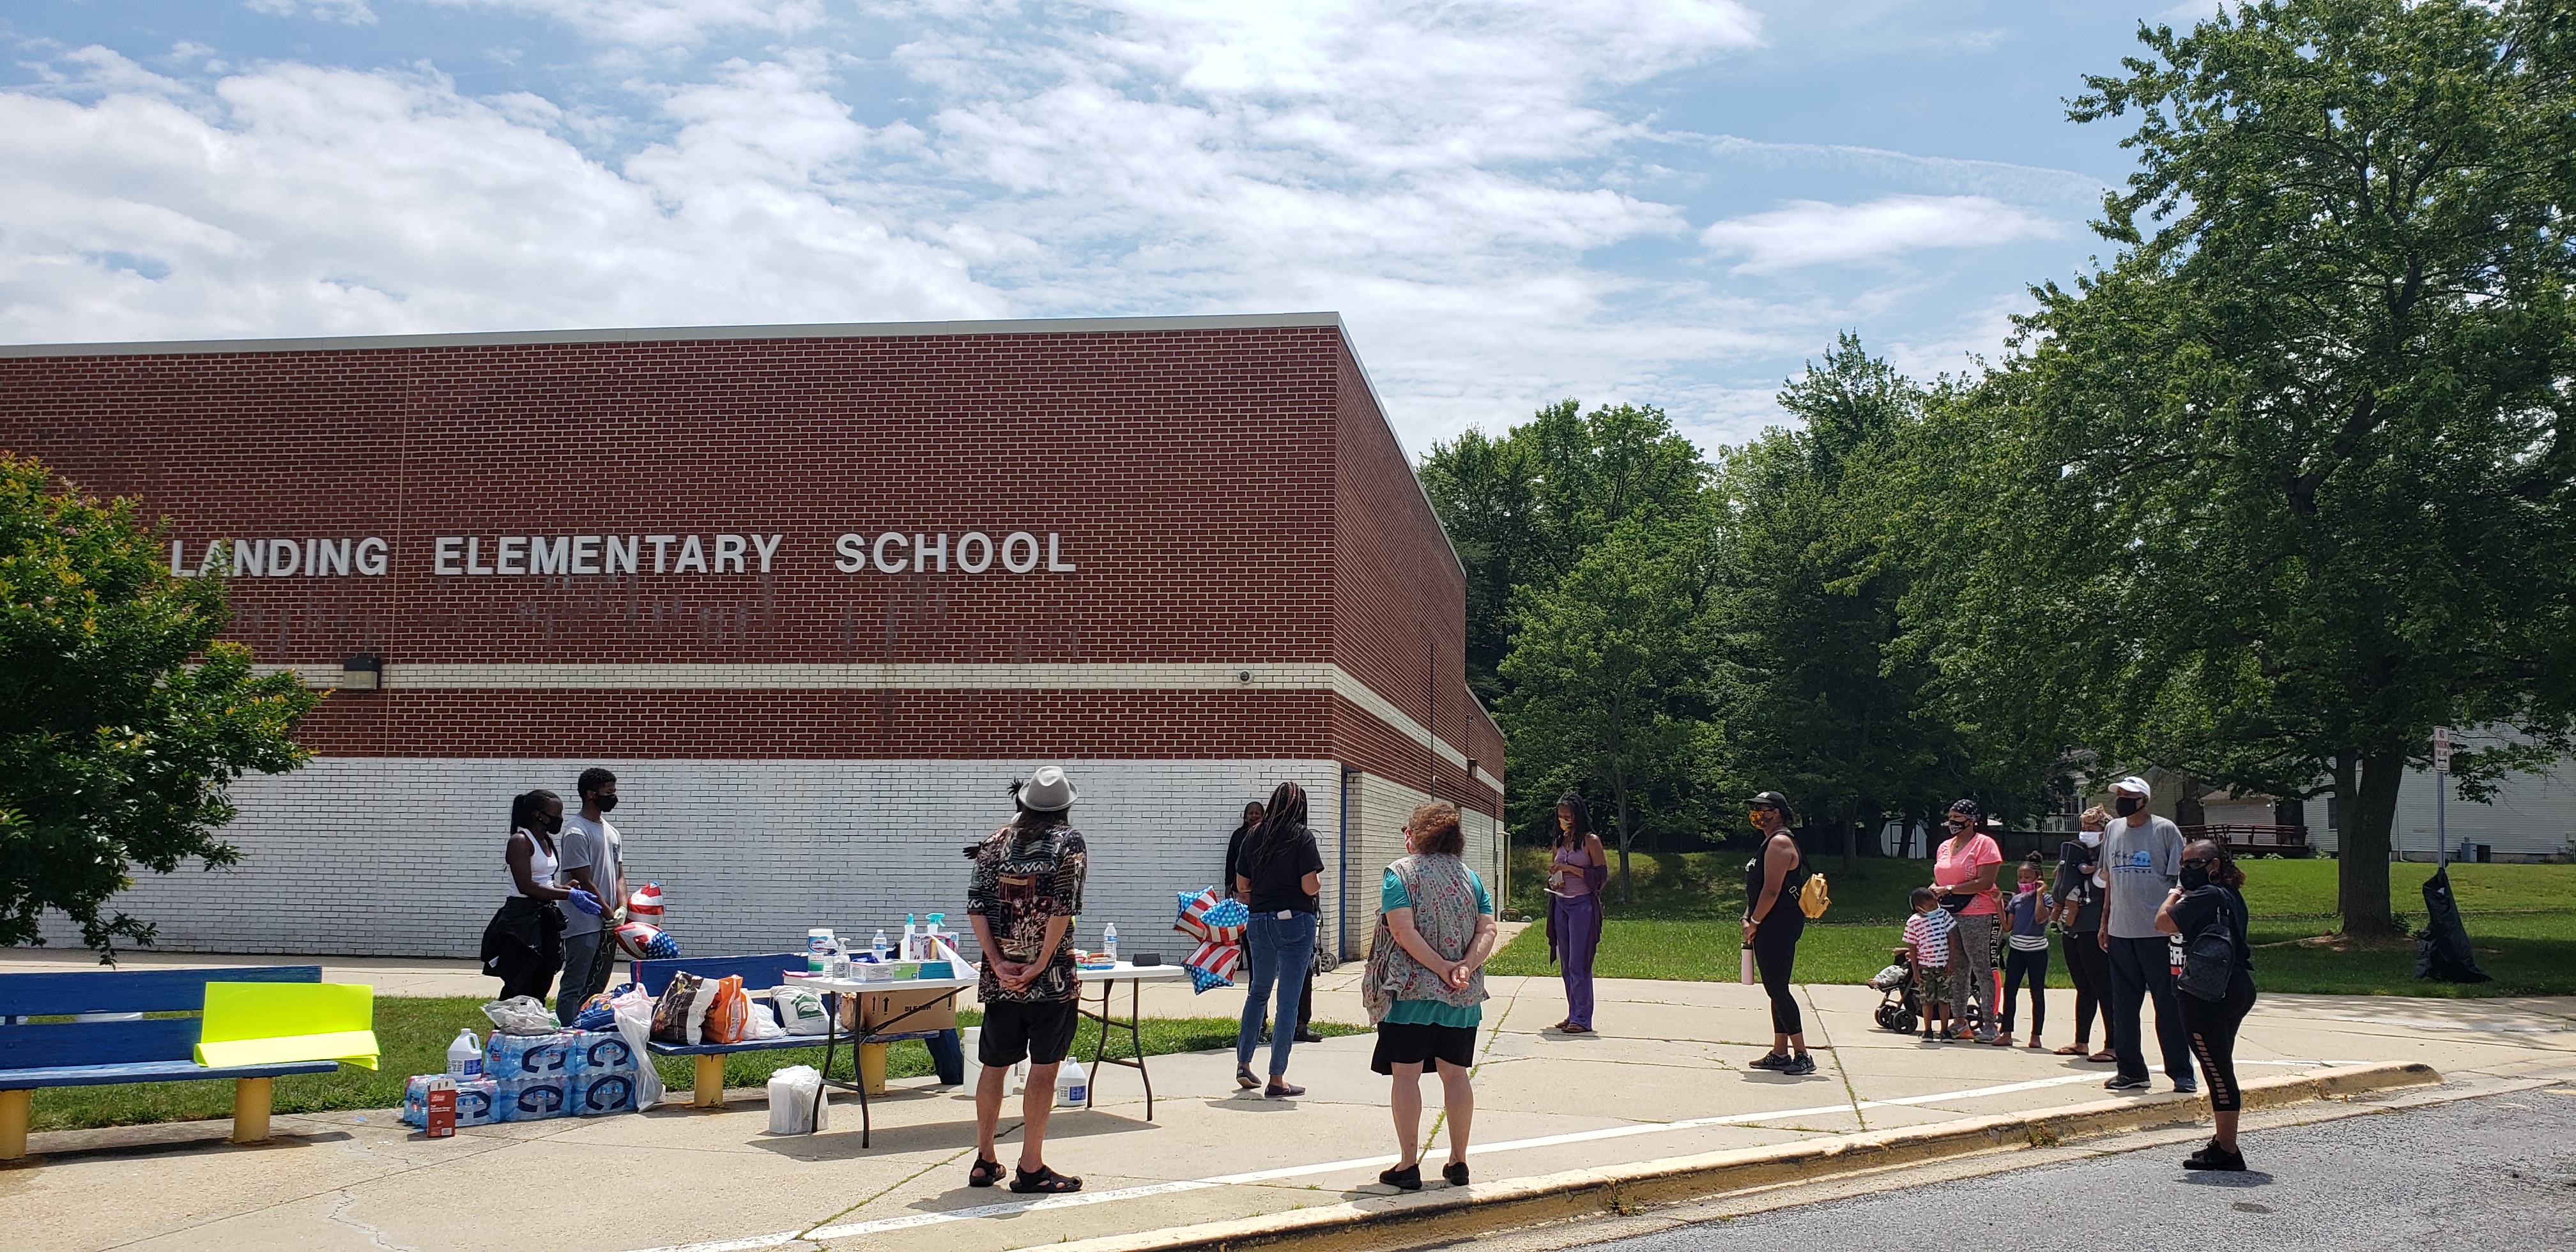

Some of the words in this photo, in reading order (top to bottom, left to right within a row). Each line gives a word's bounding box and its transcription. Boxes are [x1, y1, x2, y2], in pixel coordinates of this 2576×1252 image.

[171, 537, 388, 577] LANDING
[434, 534, 783, 575] ELEMENTARY
[834, 531, 1076, 574] SCHOOL
[2439, 729, 2444, 738] NO
